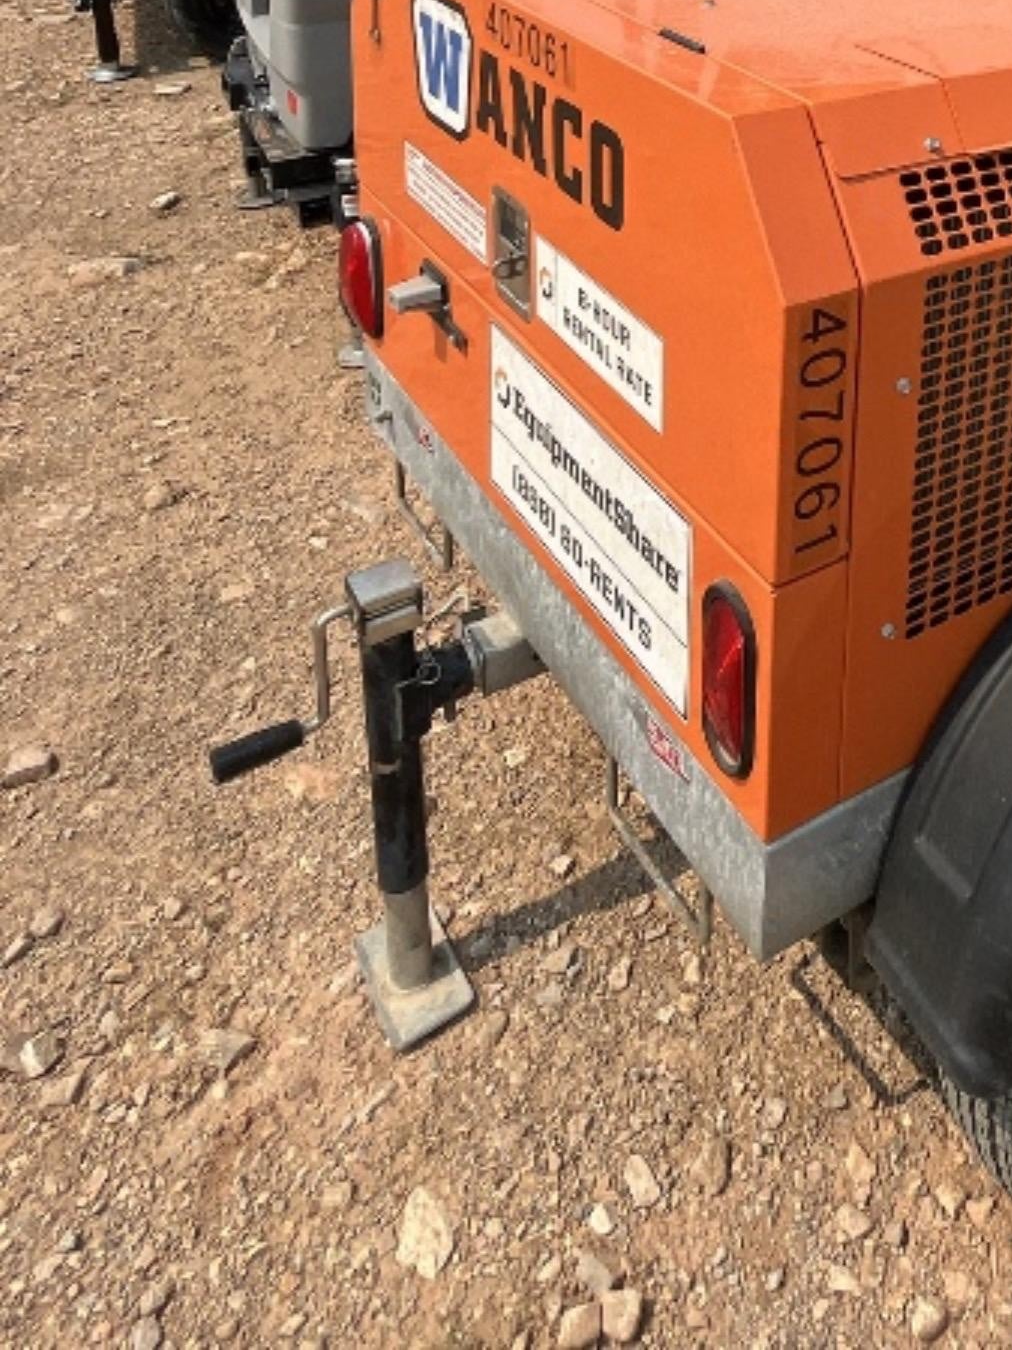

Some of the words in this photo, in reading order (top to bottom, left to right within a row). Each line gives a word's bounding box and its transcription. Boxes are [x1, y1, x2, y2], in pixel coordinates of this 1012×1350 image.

[414, 0, 625, 232] WANCO
[485, 2, 571, 83] 407061
[511, 384, 682, 594] EquipmentShare
[794, 307, 847, 554] 407061
